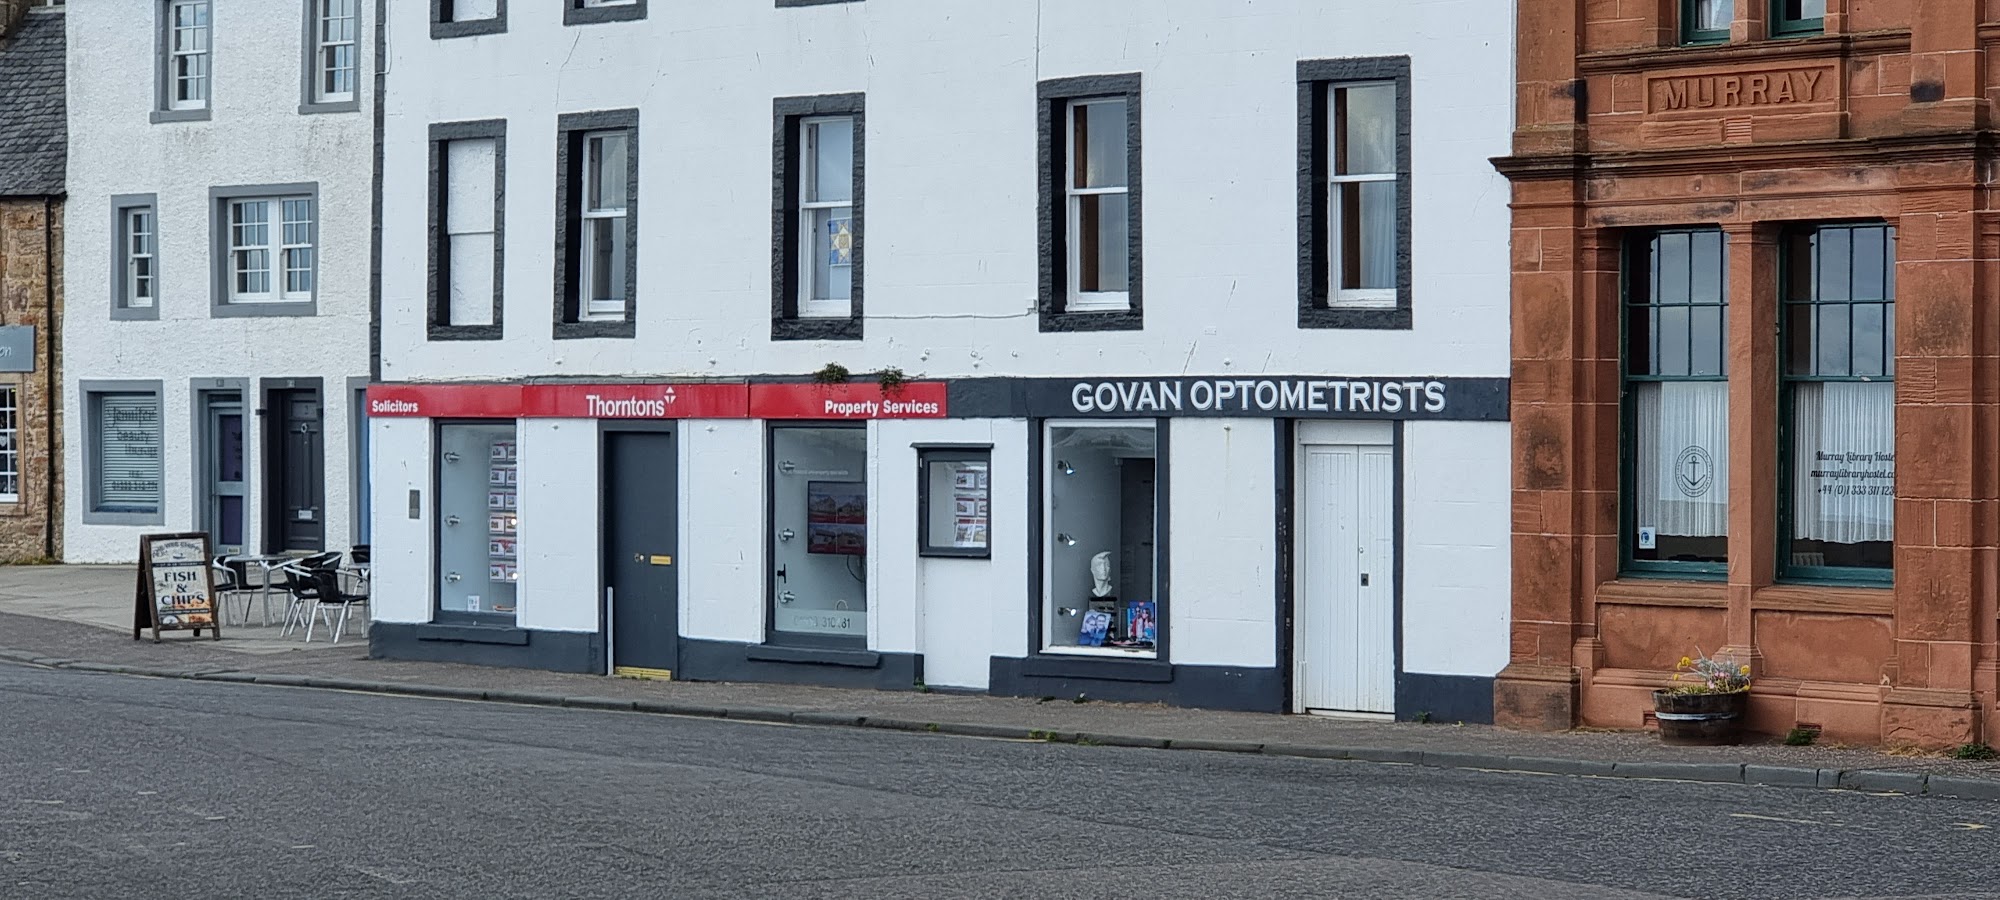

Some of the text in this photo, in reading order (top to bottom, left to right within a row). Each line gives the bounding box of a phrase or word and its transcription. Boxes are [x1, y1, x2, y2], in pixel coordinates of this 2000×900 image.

[1663, 71, 1822, 110] MURRAY
[1072, 380, 1446, 413] GOVAN OPTOMETRISTS
[372, 399, 418, 413] Solicitors
[586, 394, 665, 417] Thorntons
[824, 399, 938, 417] Property Services
[1816, 451, 1895, 464] Murray Library Hoste
[1851, 485, 1867, 496] 333
[1868, 486, 1880, 496] 311
[164, 571, 197, 582] FISH
[176, 583, 188, 593] &
[161, 593, 205, 605] CHIPS
